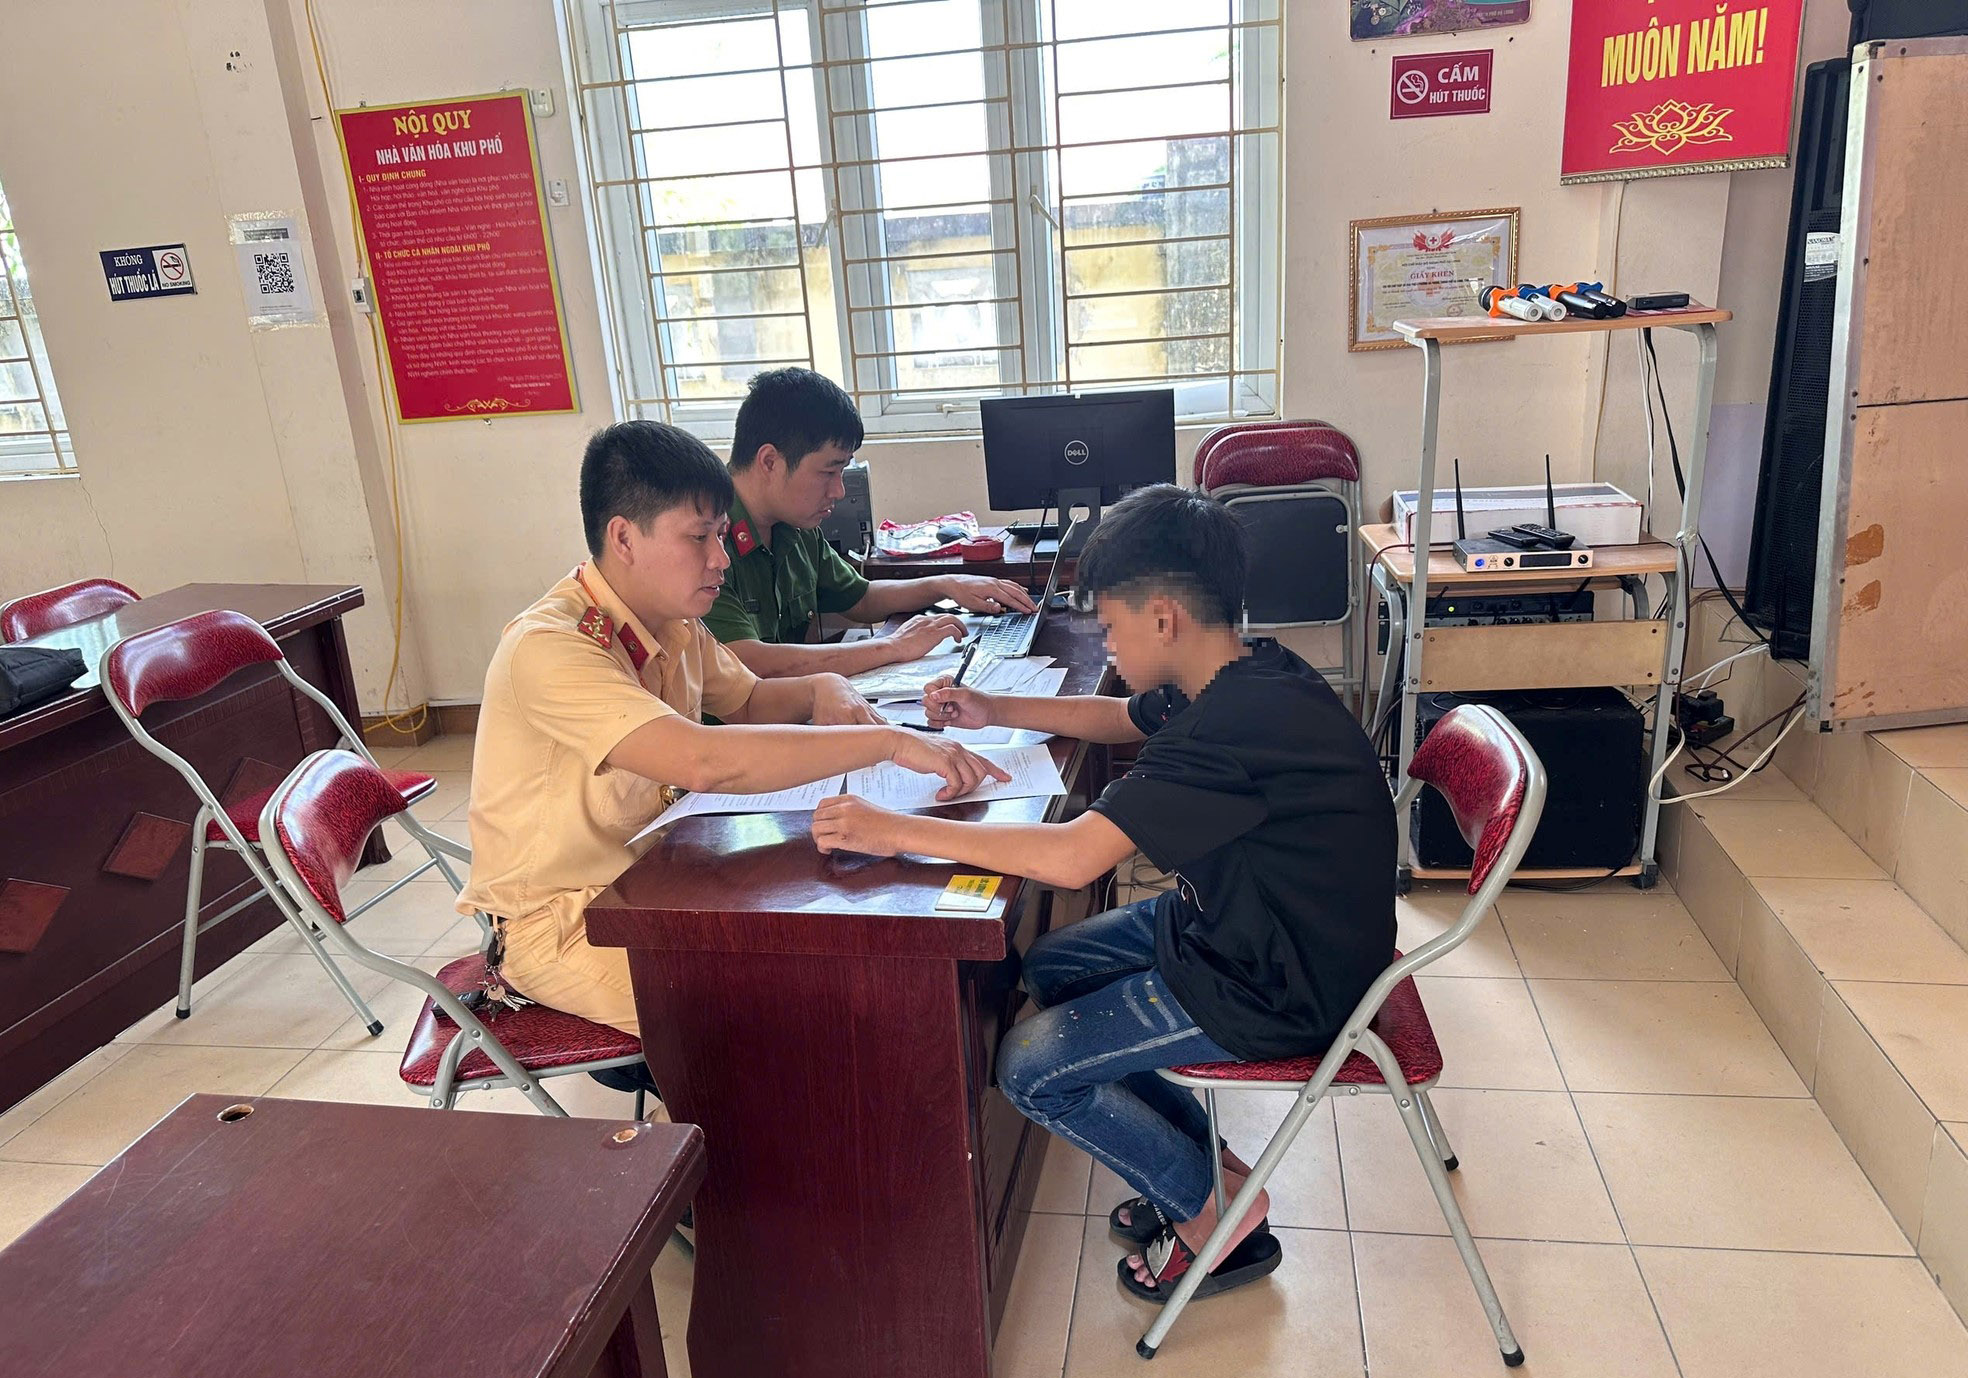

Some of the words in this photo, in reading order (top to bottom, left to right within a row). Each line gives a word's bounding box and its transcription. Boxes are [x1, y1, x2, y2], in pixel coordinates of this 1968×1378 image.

[1601, 17, 1681, 88] MUÔN
[1687, 2, 1768, 75] NĂM!
[1438, 62, 1479, 84] CẤM
[1430, 87, 1450, 104] HÚT
[1452, 84, 1486, 102] THUỐC
[393, 110, 429, 138] NỘI
[432, 109, 471, 135] QUY
[375, 144, 401, 165] NHÀ
[401, 142, 425, 162] VĂN
[427, 140, 451, 160] HÓA
[453, 139, 477, 157] KHU
[479, 132, 503, 155] PHỐ
[366, 174, 380, 183] QUY
[401, 169, 426, 179] CHUNG
[461, 243, 476, 252] KHU
[114, 252, 143, 266] KHÔNG
[109, 273, 125, 294] HÚT
[124, 268, 149, 293] THUỐC
[148, 270, 160, 291] LÁ
[1410, 270, 1430, 280] GIẤY
[1432, 270, 1454, 278] KHEN
